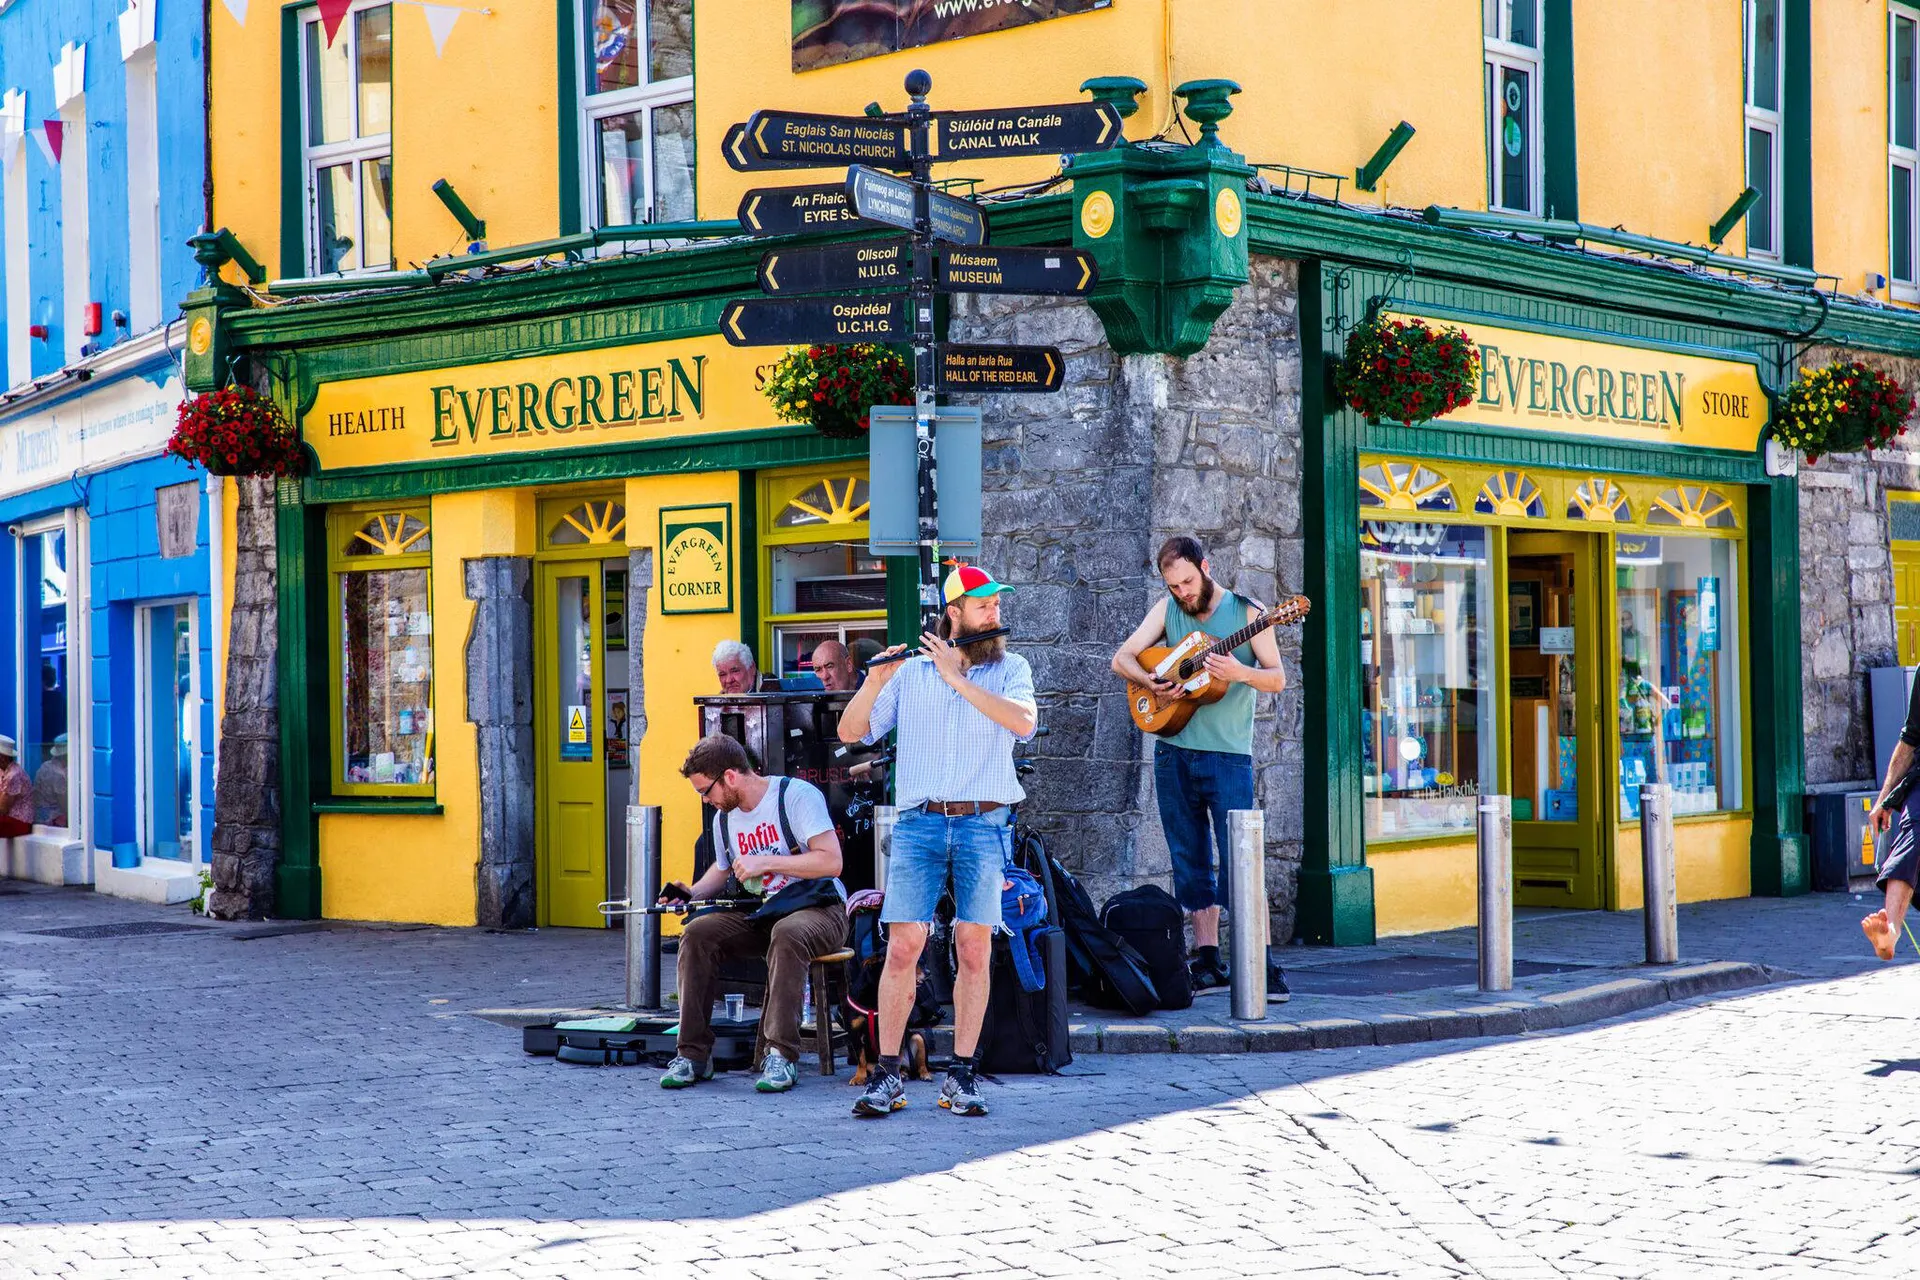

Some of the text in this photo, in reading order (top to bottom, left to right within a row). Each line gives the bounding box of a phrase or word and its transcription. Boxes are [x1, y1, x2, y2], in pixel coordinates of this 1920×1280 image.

[785, 122, 895, 141] Eaglais San Nioclás
[949, 114, 1062, 133] Siúlóid na Canála
[782, 140, 896, 158] ST. NICHOLAS CHURCH
[949, 133, 1040, 150] CANAL WALK
[792, 195, 808, 207] An
[805, 209, 837, 223] EYRE
[857, 246, 898, 261] Ollscoil
[949, 253, 998, 267] Músaem
[858, 264, 899, 278] N.U.I.G.
[949, 270, 1002, 284] MUSEUM
[833, 302, 891, 319] Ospidéal
[837, 320, 892, 333] U.C.H.G.
[946, 354, 966, 366] Halla
[967, 357, 977, 366] an
[997, 355, 1013, 367] Rua
[946, 370, 1038, 383] HALL OF THE RED EARL
[1478, 343, 1750, 433] EVERGREEN STORE
[329, 406, 405, 437] HEALTH
[430, 354, 707, 447] EVERGREEN
[668, 537, 722, 575] EVERGREEN
[669, 581, 722, 596] CORNER
[1439, 778, 1480, 799] Hauschka
[737, 822, 779, 856] Bofin
